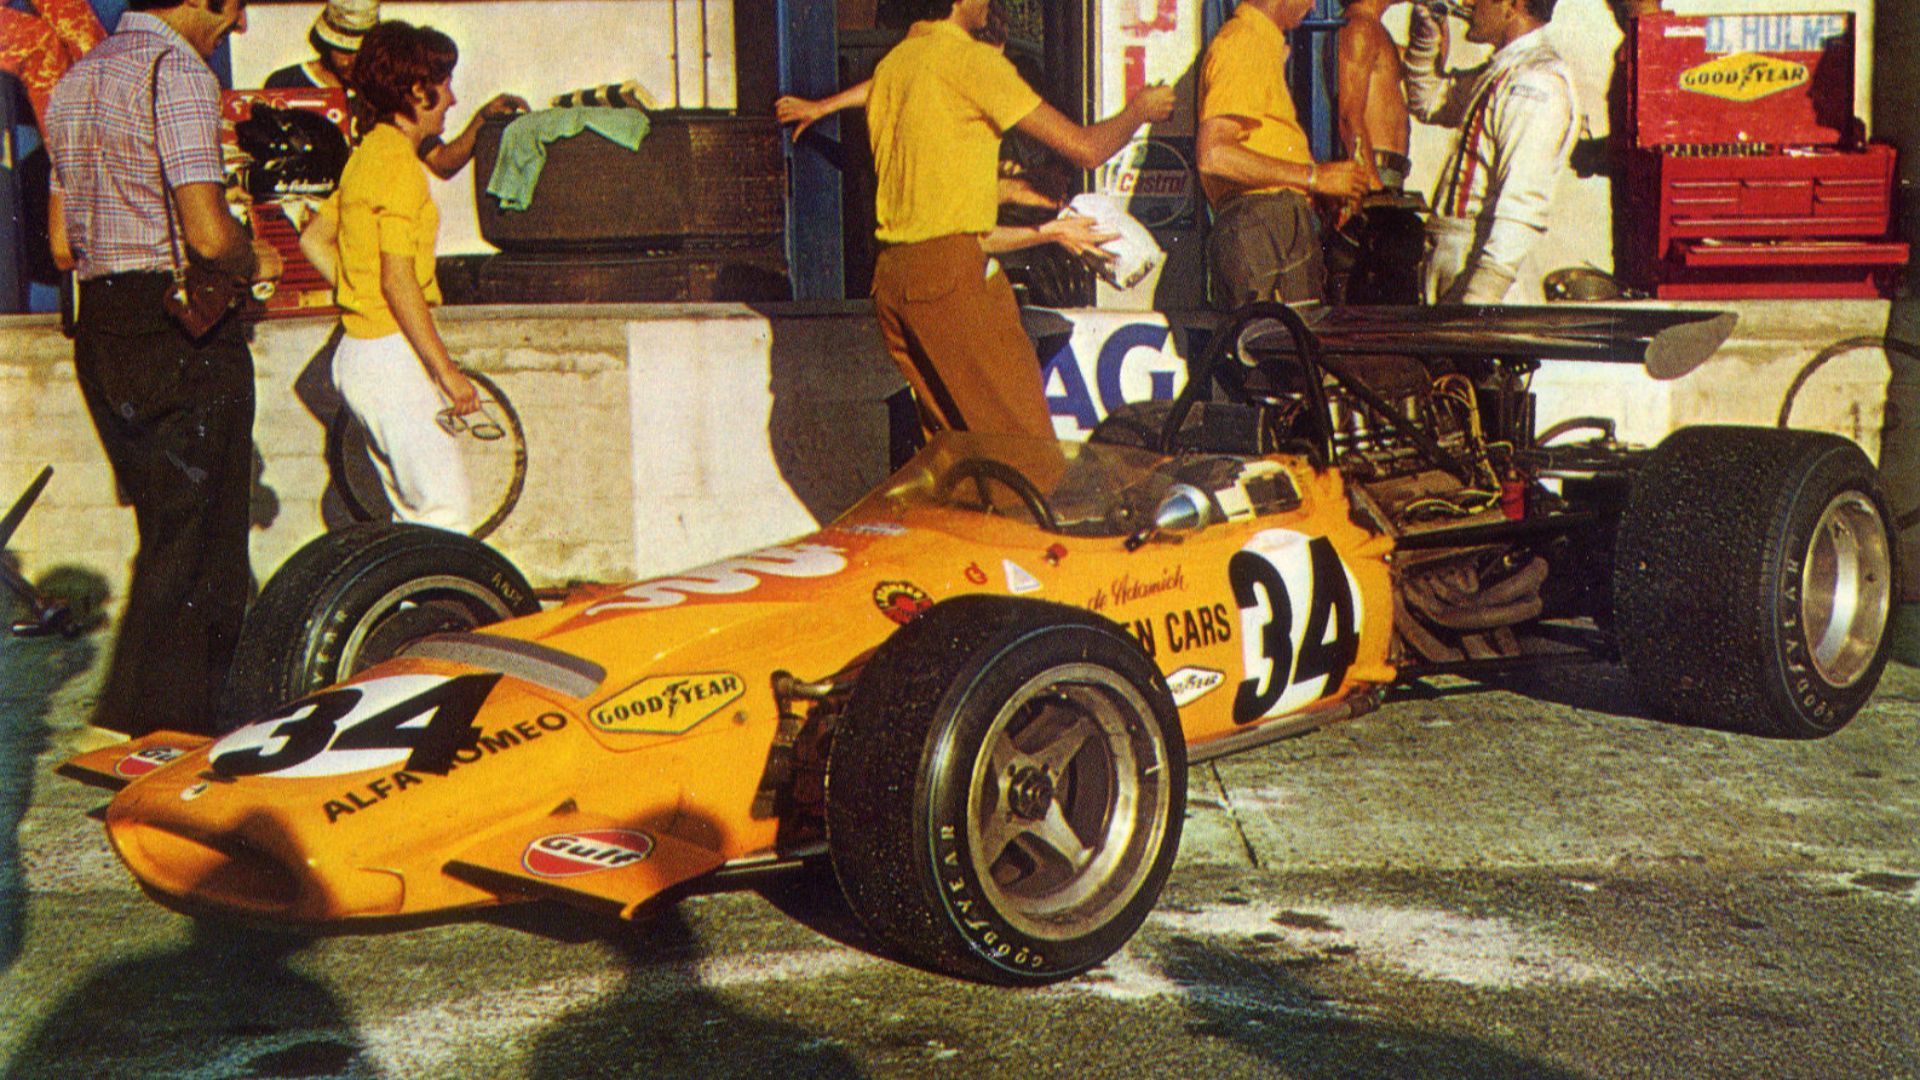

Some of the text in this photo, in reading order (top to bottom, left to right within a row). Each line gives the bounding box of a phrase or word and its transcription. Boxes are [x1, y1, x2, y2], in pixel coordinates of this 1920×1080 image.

[1684, 64, 1805, 86] GOODYEAR
[1165, 603, 1231, 653] CARS
[1228, 535, 1361, 725] 34
[211, 673, 503, 776] 34
[596, 675, 739, 726] GOODYEAR
[322, 712, 568, 824] ALFA OMEO
[540, 836, 642, 864] Gulf
[940, 825, 1043, 968] GOODYEAR
